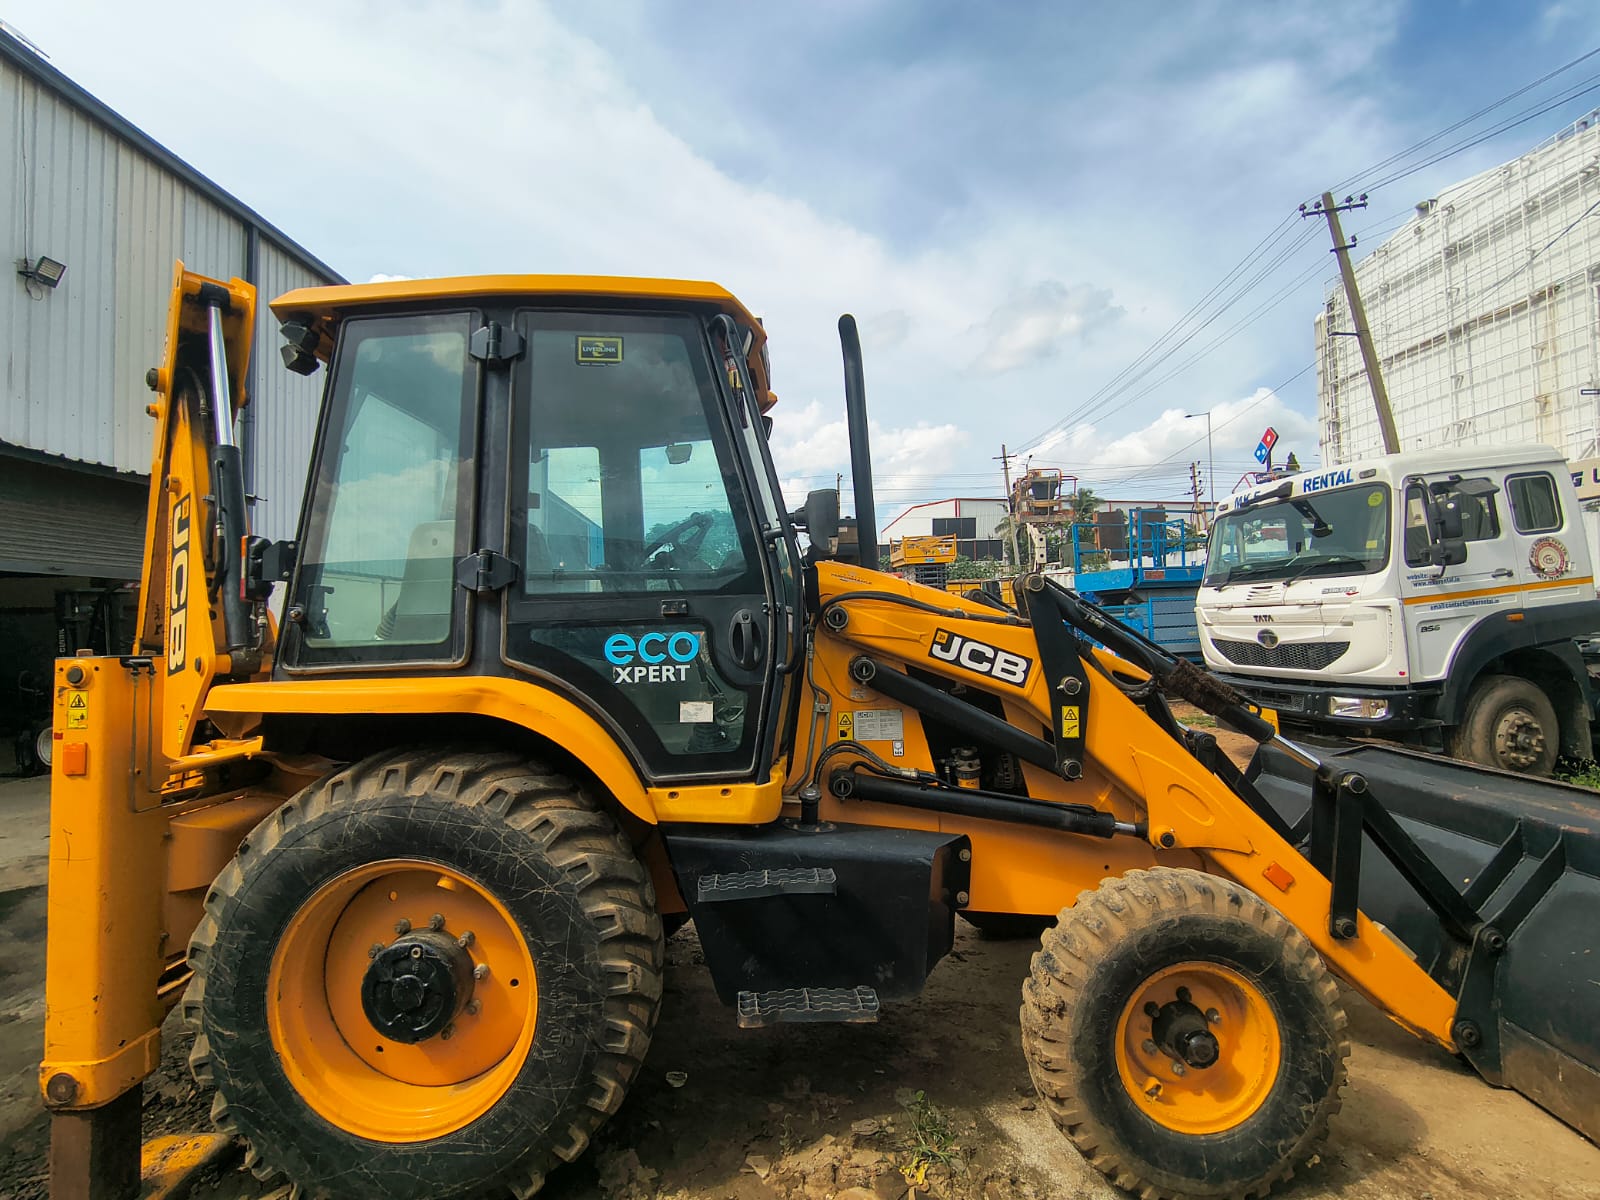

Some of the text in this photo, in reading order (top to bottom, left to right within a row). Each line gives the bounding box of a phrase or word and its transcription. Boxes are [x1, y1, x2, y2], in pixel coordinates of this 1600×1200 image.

[1303, 468, 1354, 493] RENTAL
[169, 503, 189, 671] JCB
[1253, 614, 1274, 623] TATA
[604, 631, 700, 665] eco
[931, 635, 1028, 684] JCB
[614, 664, 691, 684] XPERT
